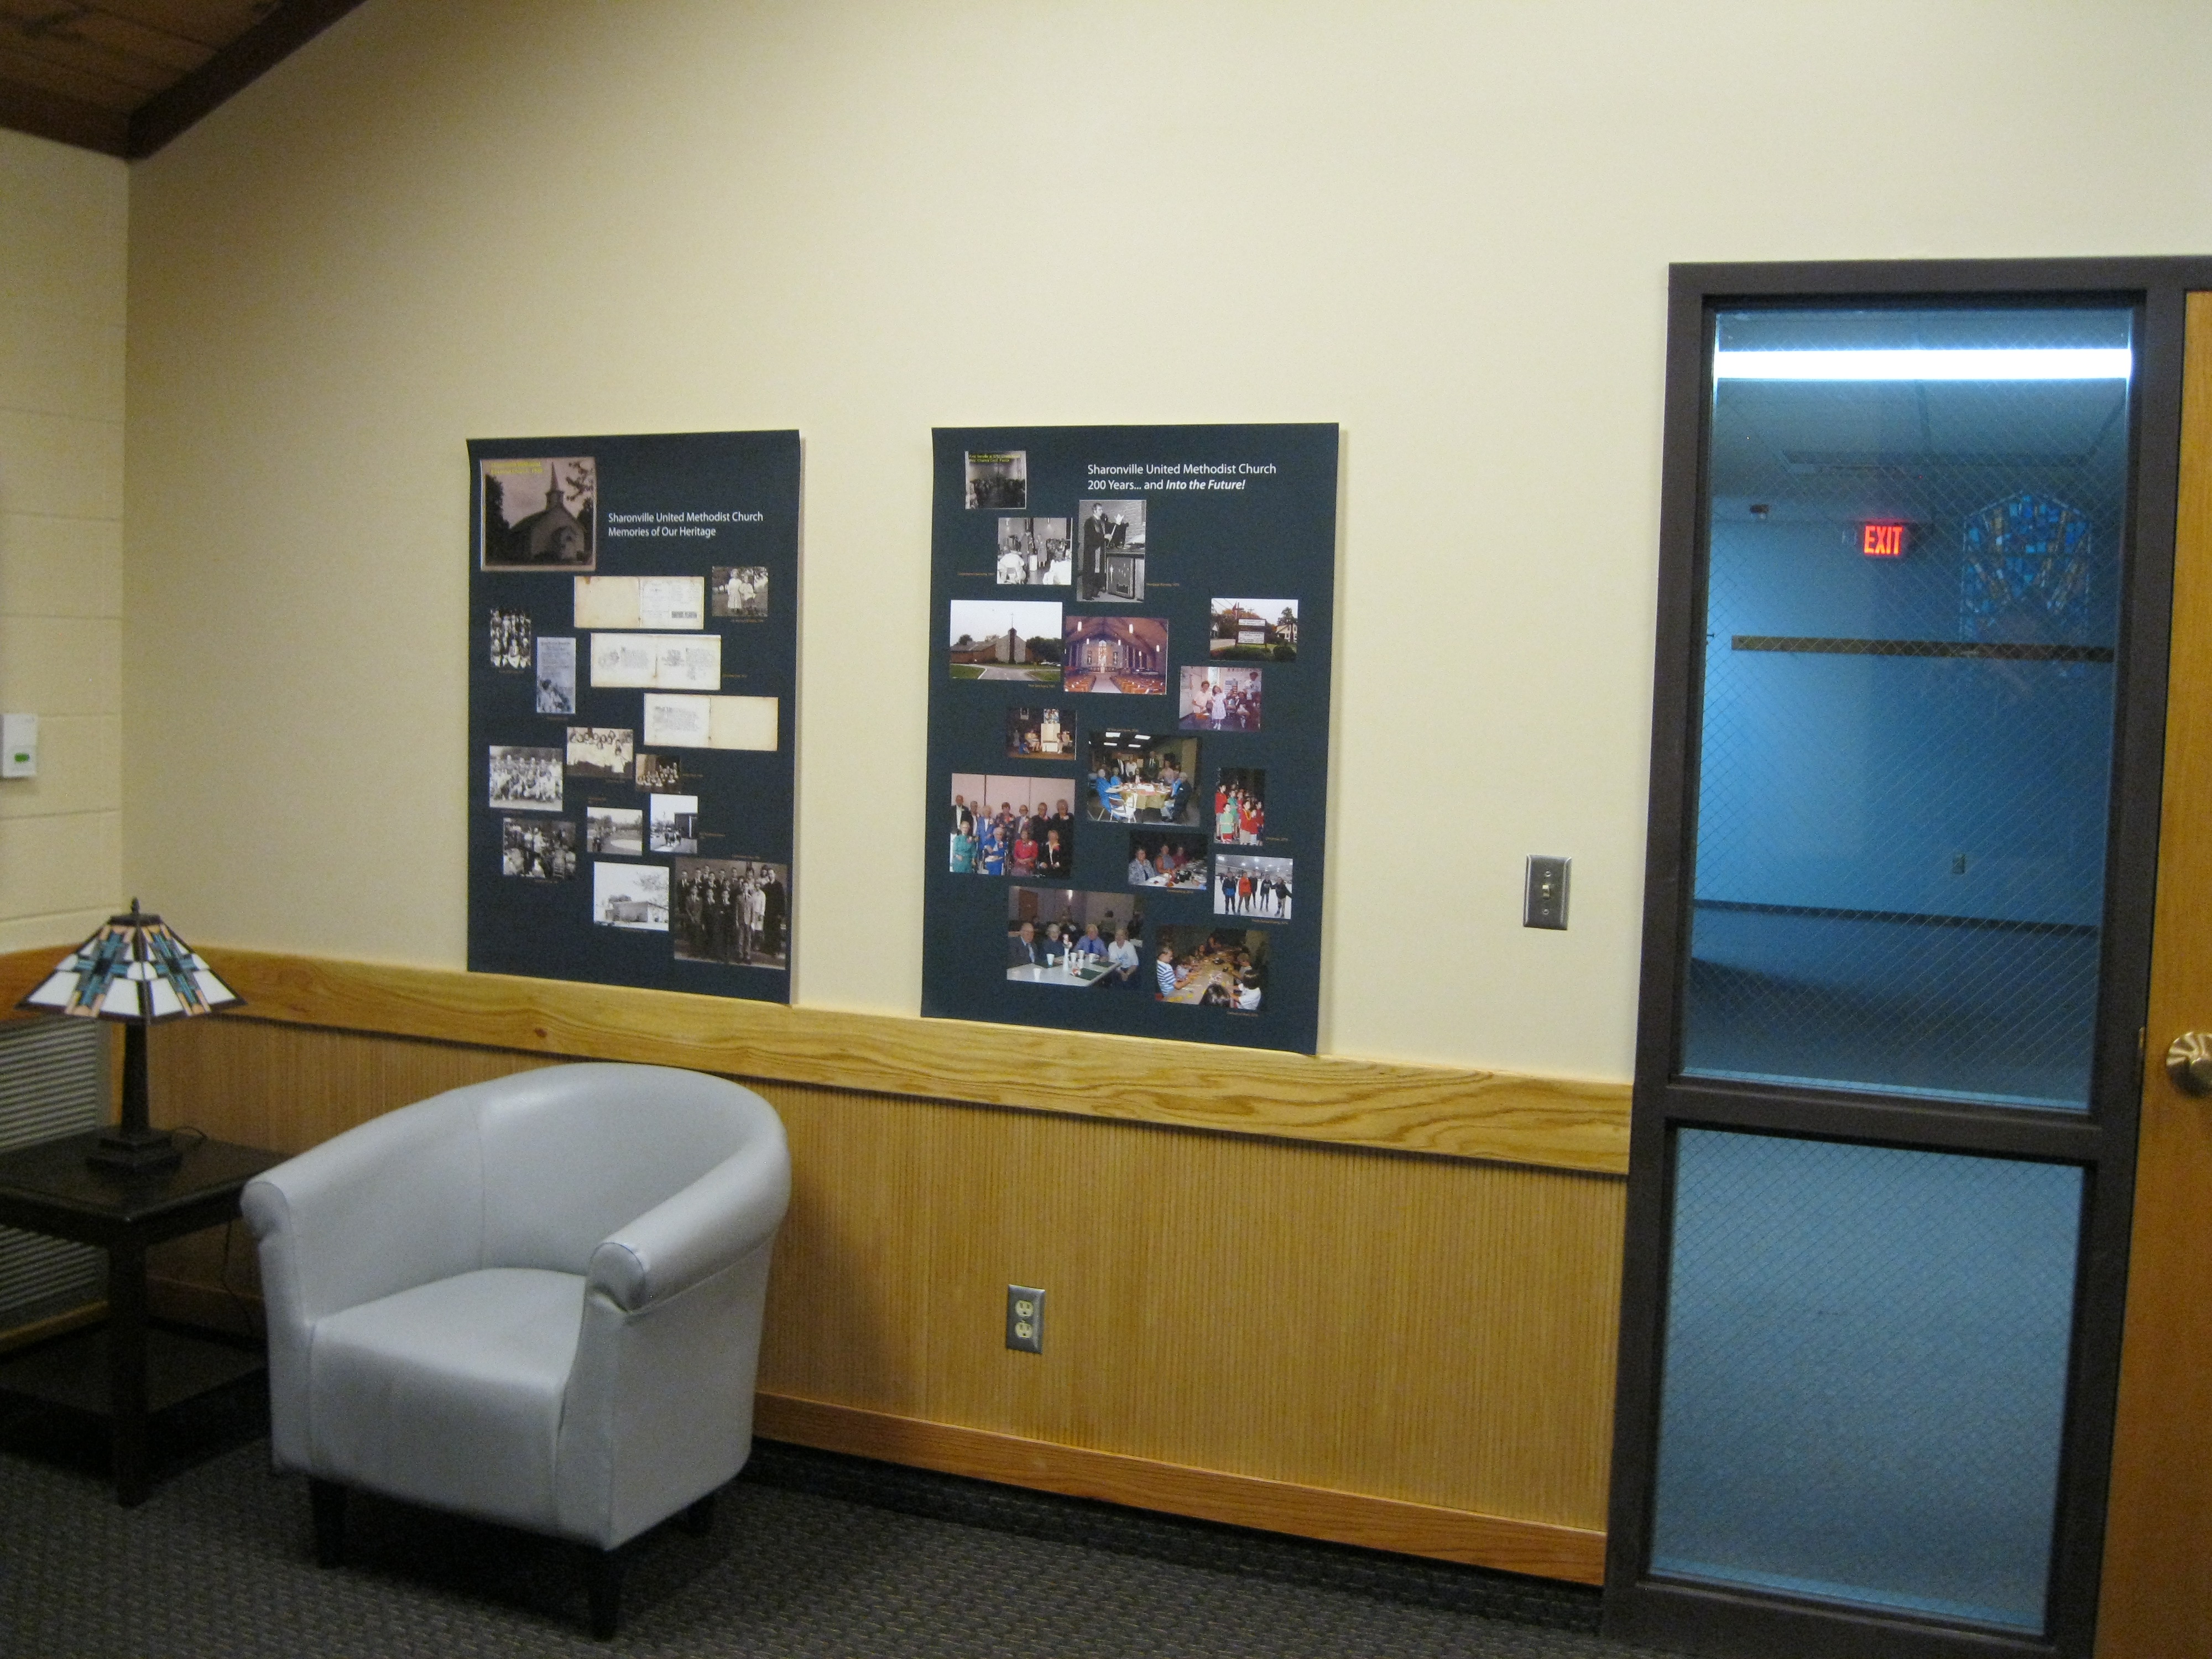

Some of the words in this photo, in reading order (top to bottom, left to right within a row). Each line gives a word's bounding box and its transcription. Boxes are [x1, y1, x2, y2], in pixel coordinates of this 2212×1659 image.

[1088, 463, 1144, 474] Sharonville
[1146, 463, 1181, 474] United
[1183, 463, 1237, 474] Methodist
[1238, 463, 1276, 474] Church
[1087, 479, 1107, 490] 200
[1108, 479, 1142, 490] Years...
[1144, 479, 1164, 490] and
[1166, 479, 1187, 490] Into
[1188, 478, 1207, 490] the
[1207, 479, 1246, 490] Future!
[608, 512, 654, 523] Sharonville
[656, 512, 685, 523] United
[686, 511, 730, 522] Methodist
[732, 511, 763, 522] Church
[608, 526, 649, 537] Memories
[650, 526, 660, 537] of
[661, 526, 678, 537] Our
[679, 526, 716, 539] Heritage
[1864, 525, 1903, 555] EXIT
